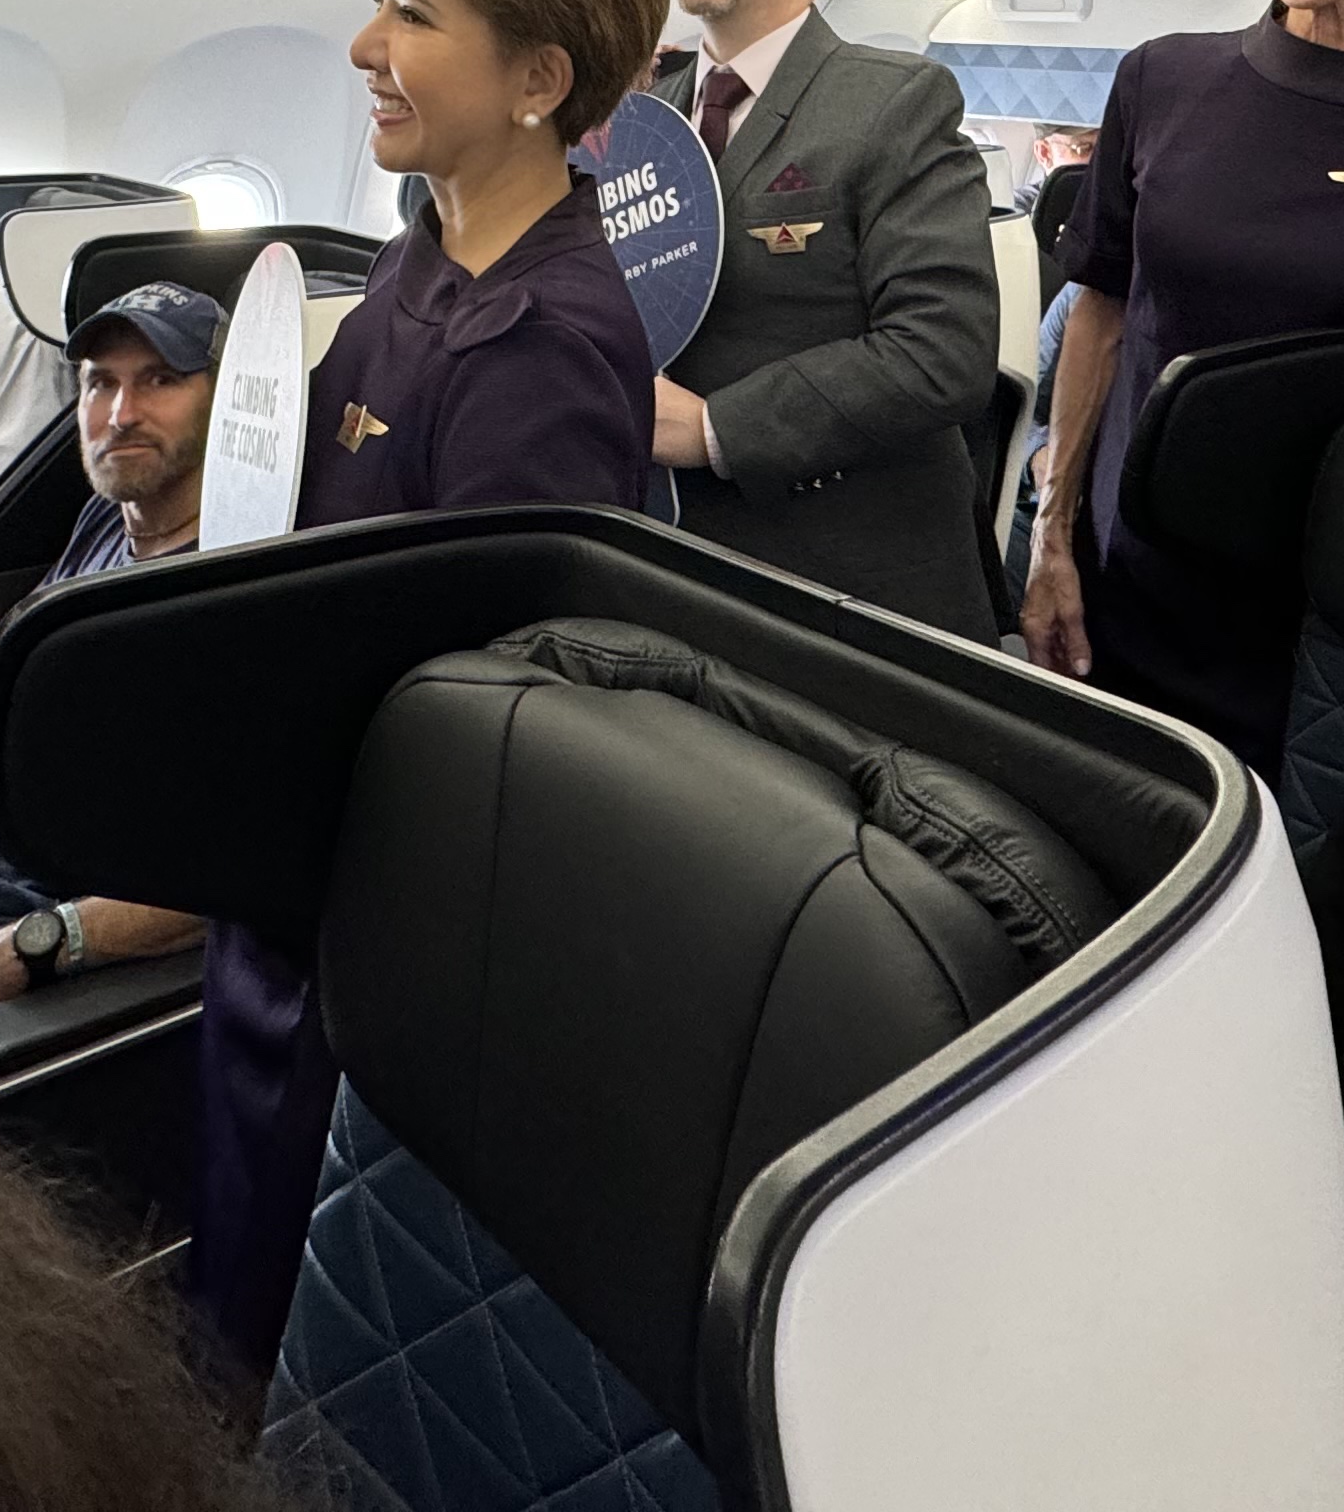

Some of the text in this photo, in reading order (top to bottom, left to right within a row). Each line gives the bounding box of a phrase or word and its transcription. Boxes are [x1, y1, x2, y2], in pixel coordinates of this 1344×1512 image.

[596, 161, 658, 214] BING
[601, 186, 681, 245] OSMOS
[623, 240, 699, 281] RBY PARKER
[231, 373, 279, 419] CLIMBING
[219, 417, 280, 475] THE COSMOS
